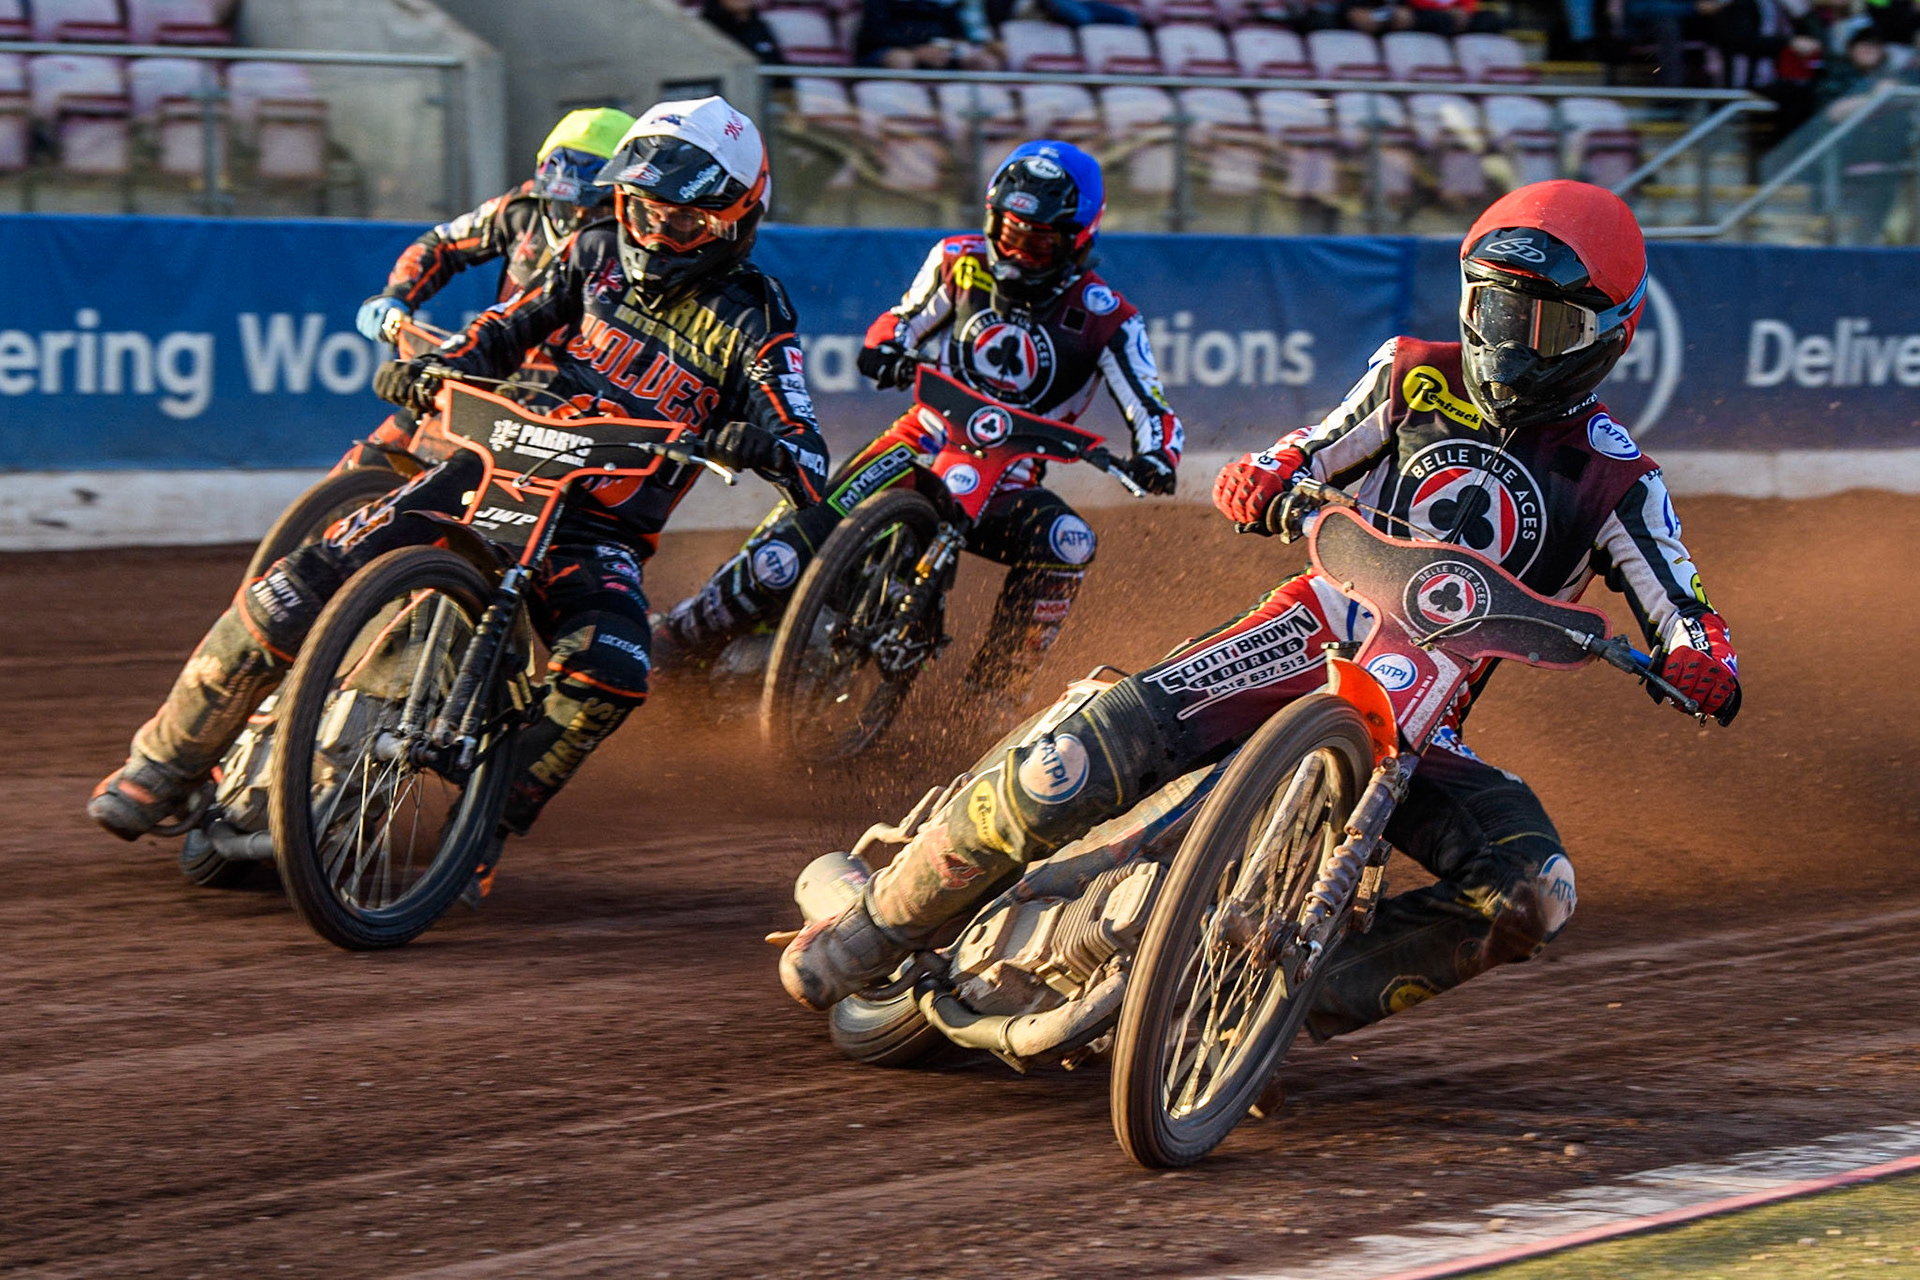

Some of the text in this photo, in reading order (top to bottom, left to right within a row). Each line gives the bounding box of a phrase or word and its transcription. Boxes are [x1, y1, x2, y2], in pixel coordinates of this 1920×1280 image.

[1032, 334, 1050, 369] ACES
[1411, 371, 1480, 424] Rentruck
[1599, 422, 1633, 450] ATPI
[1411, 448, 1538, 541] BELLE VUE ACES
[474, 506, 539, 526] JWP
[1058, 528, 1092, 547] ATPI
[1417, 565, 1487, 605] BELLE VUE ACES
[1160, 607, 1321, 692] SCOTT BROWN
[1194, 639, 1300, 689] FLOORING
[1374, 662, 1407, 682] ATPI
[1041, 742, 1070, 788] ATPI
